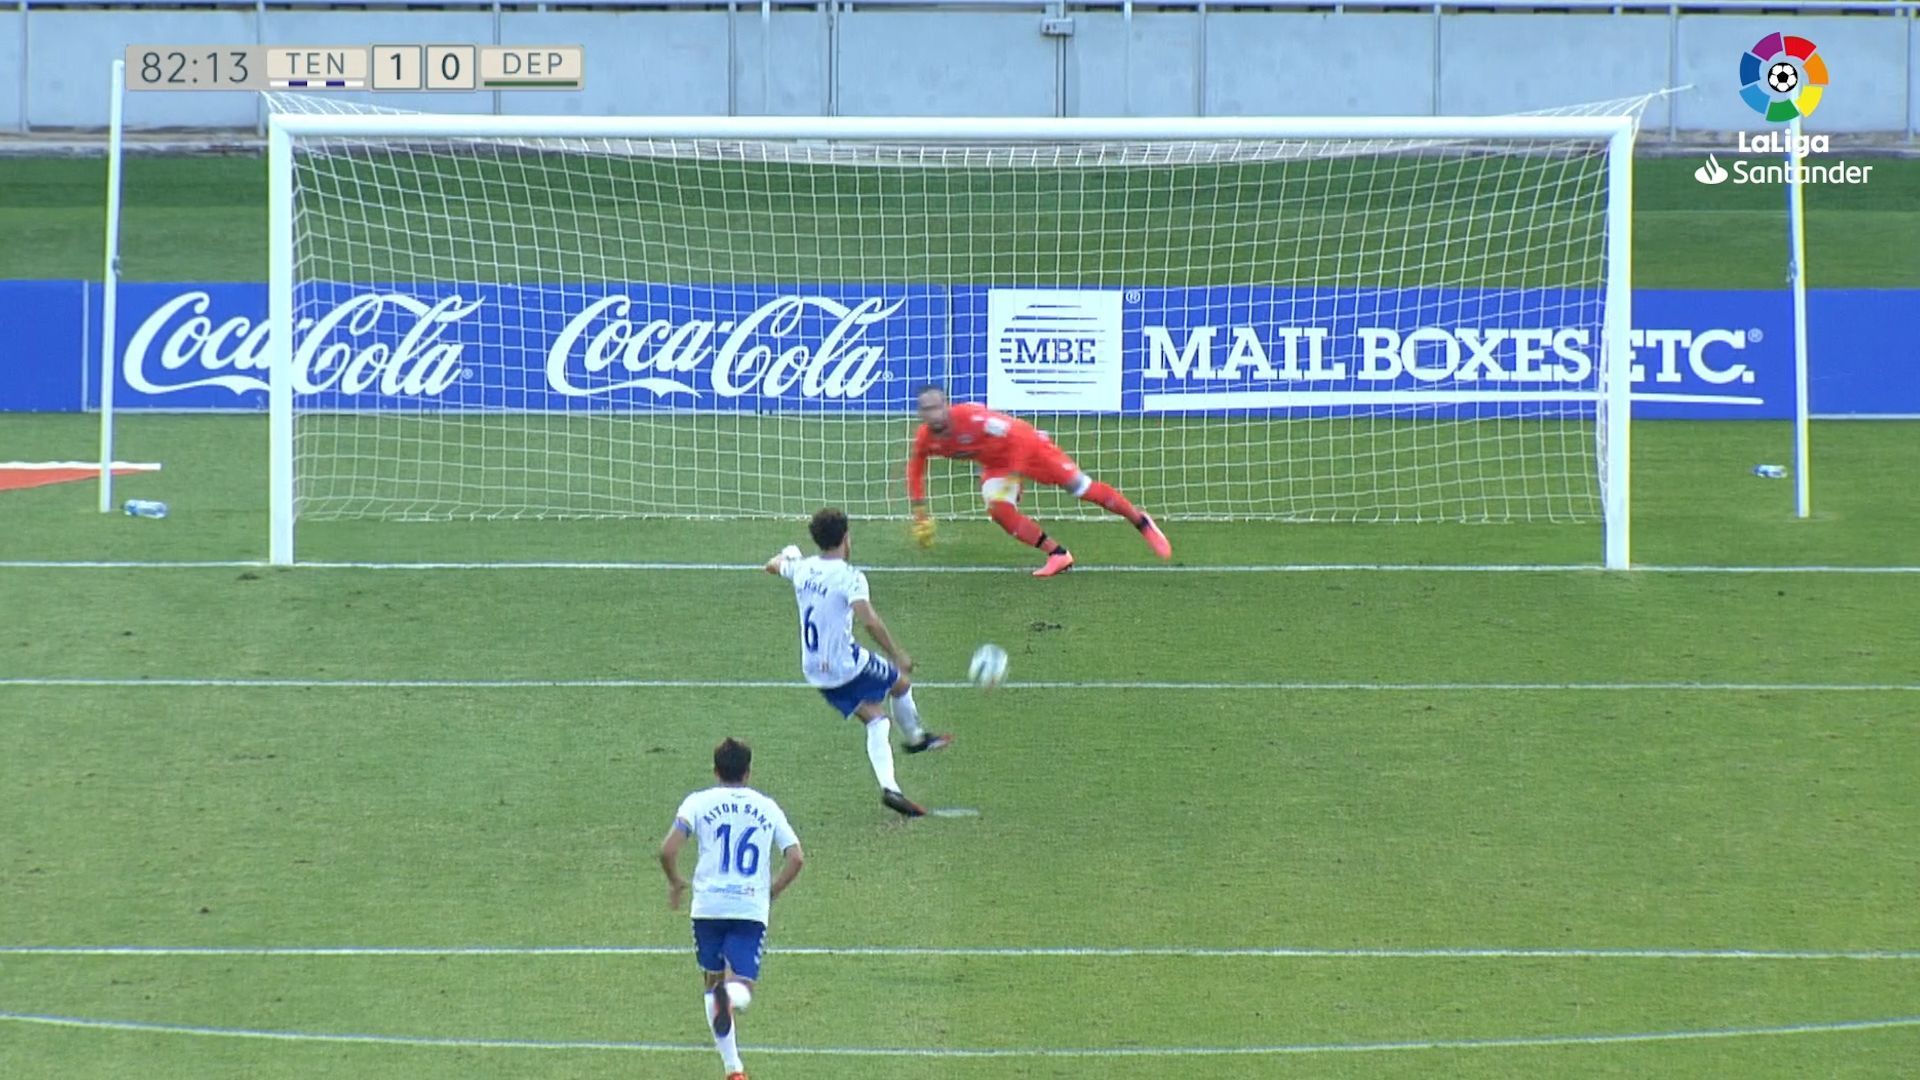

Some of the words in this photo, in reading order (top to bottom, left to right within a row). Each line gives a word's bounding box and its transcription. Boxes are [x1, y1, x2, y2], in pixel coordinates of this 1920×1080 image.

[546, 294, 907, 399] Coca-Cola
[1015, 337, 1096, 364] MBE
[1143, 325, 1346, 381] MAIL
[1357, 327, 1592, 382] BOXES
[803, 605, 819, 653] 6
[703, 803, 739, 825] AITOR
[716, 824, 760, 877] 16
